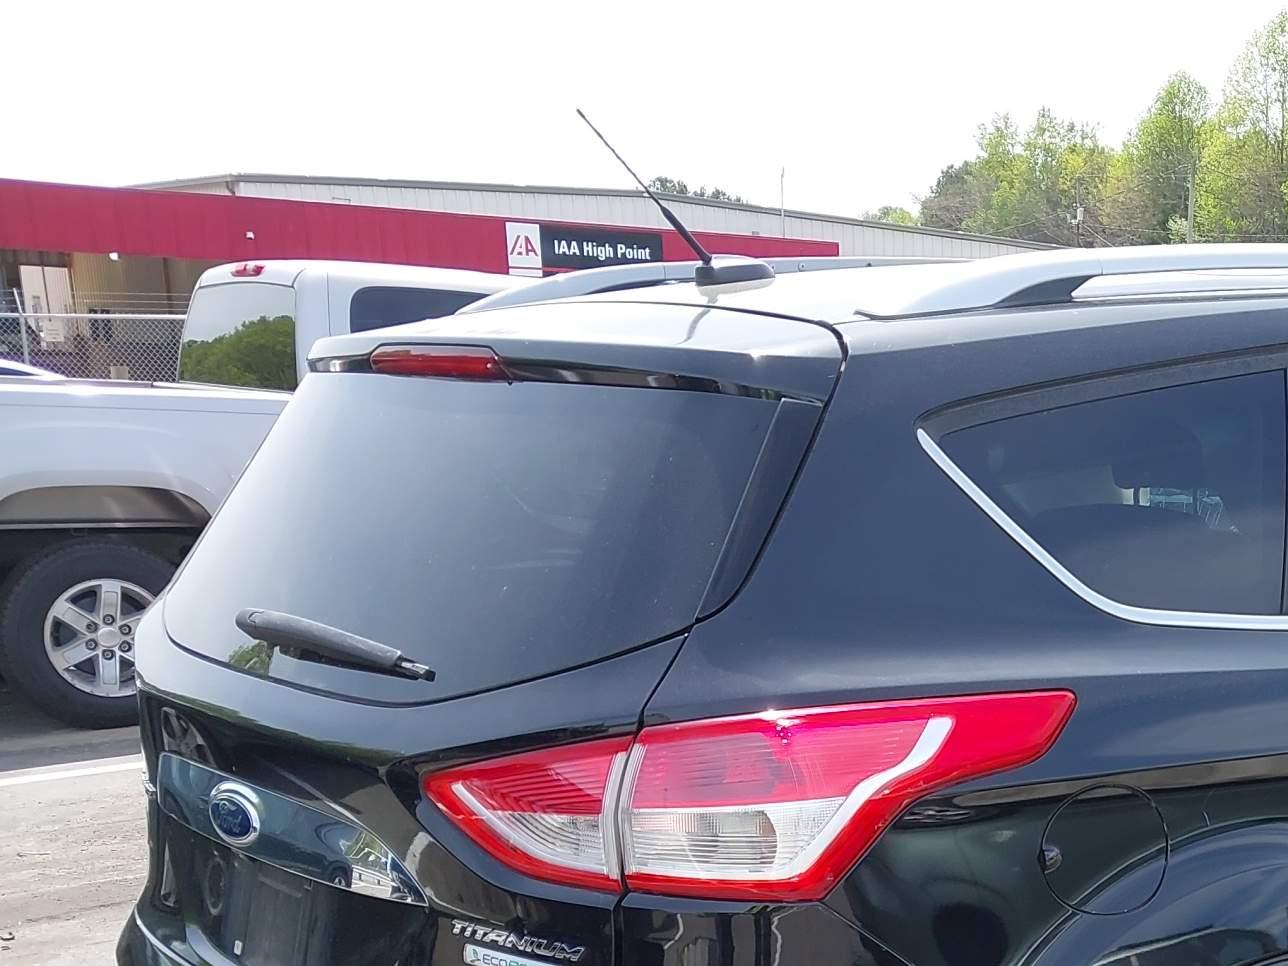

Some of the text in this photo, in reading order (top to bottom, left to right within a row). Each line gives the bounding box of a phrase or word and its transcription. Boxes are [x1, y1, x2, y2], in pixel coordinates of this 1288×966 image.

[554, 240, 651, 260] IAA High Point
[451, 919, 585, 962] TITANIUM
